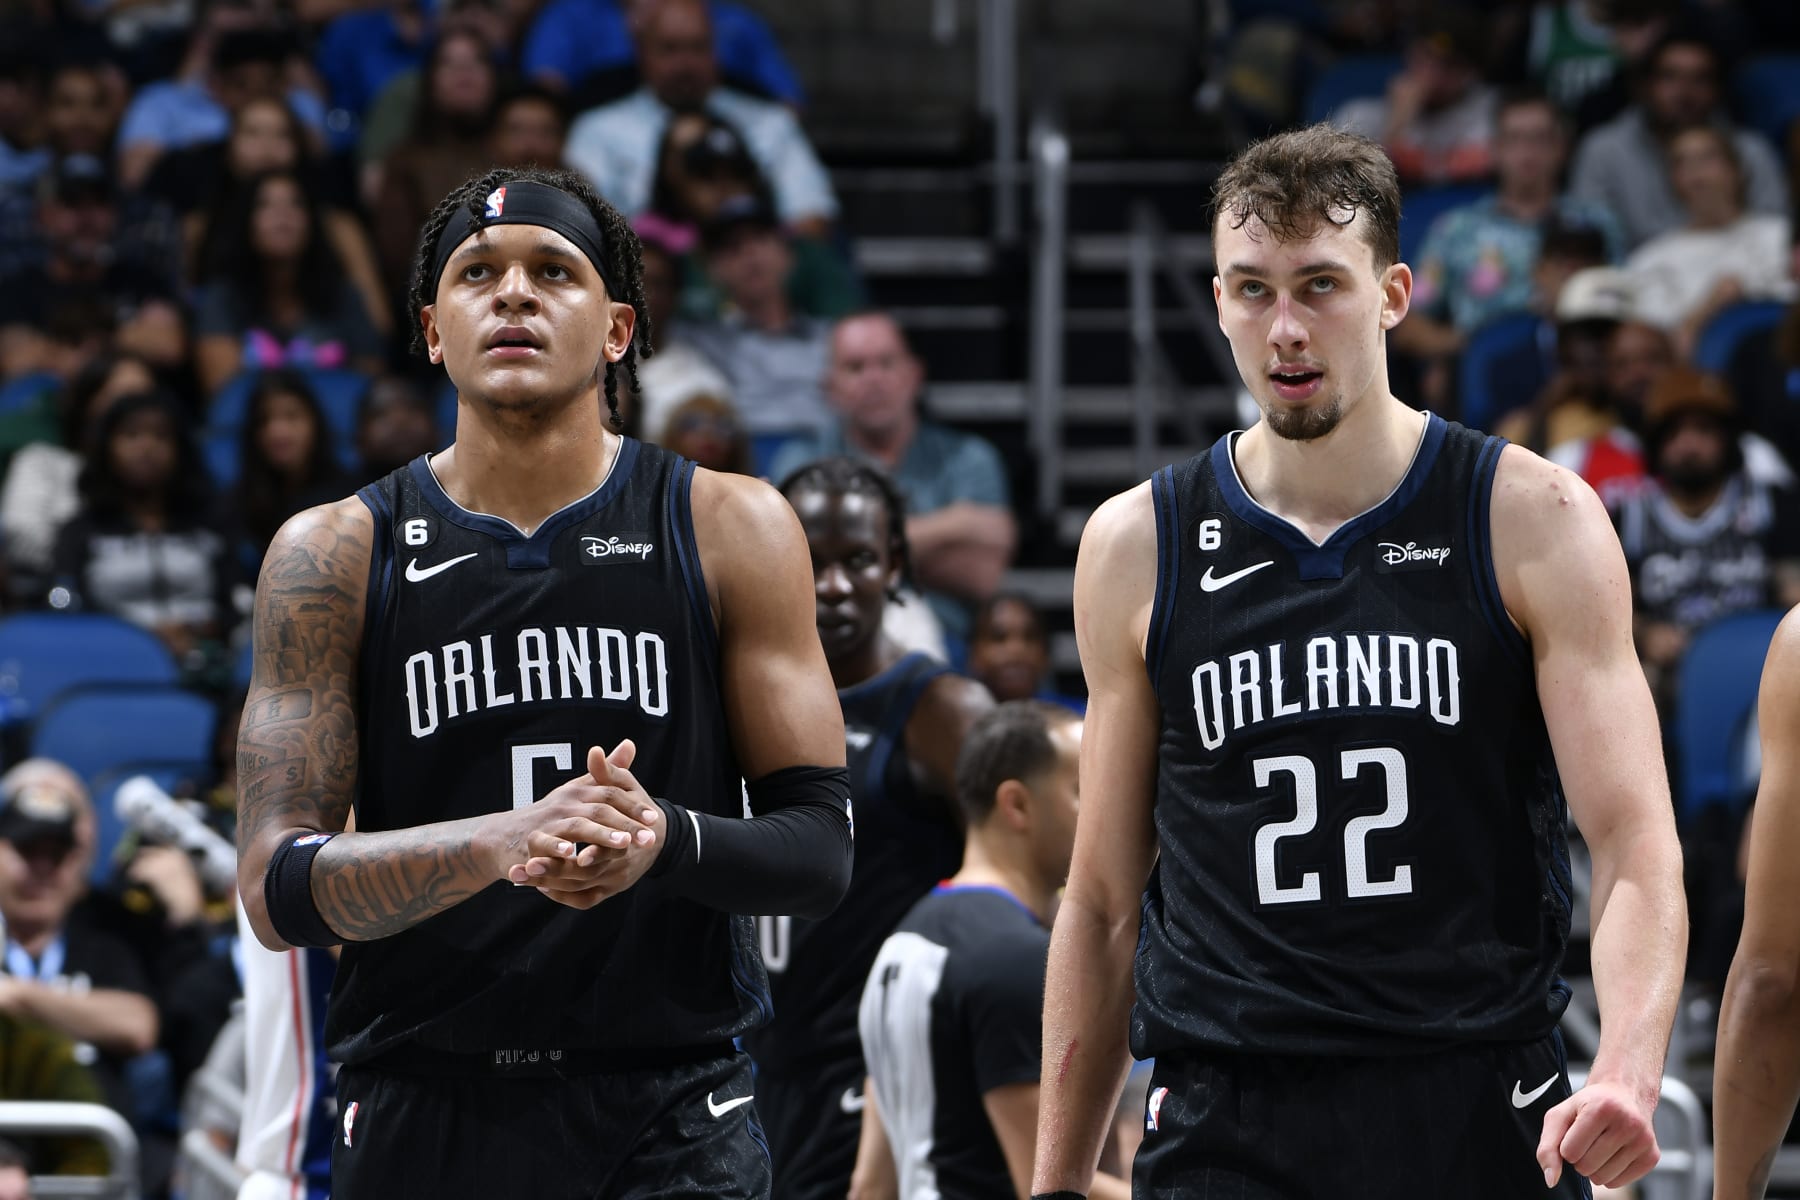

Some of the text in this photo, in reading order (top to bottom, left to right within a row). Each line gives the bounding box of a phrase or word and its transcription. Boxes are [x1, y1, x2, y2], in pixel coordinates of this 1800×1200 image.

[404, 518, 428, 546] 6
[581, 536, 654, 561] Disney
[1198, 518, 1222, 551] 6
[1377, 541, 1451, 566] Disney
[404, 626, 669, 739] ORLANDO
[1191, 634, 1461, 751] ORLANDO
[1252, 747, 1413, 905] 22
